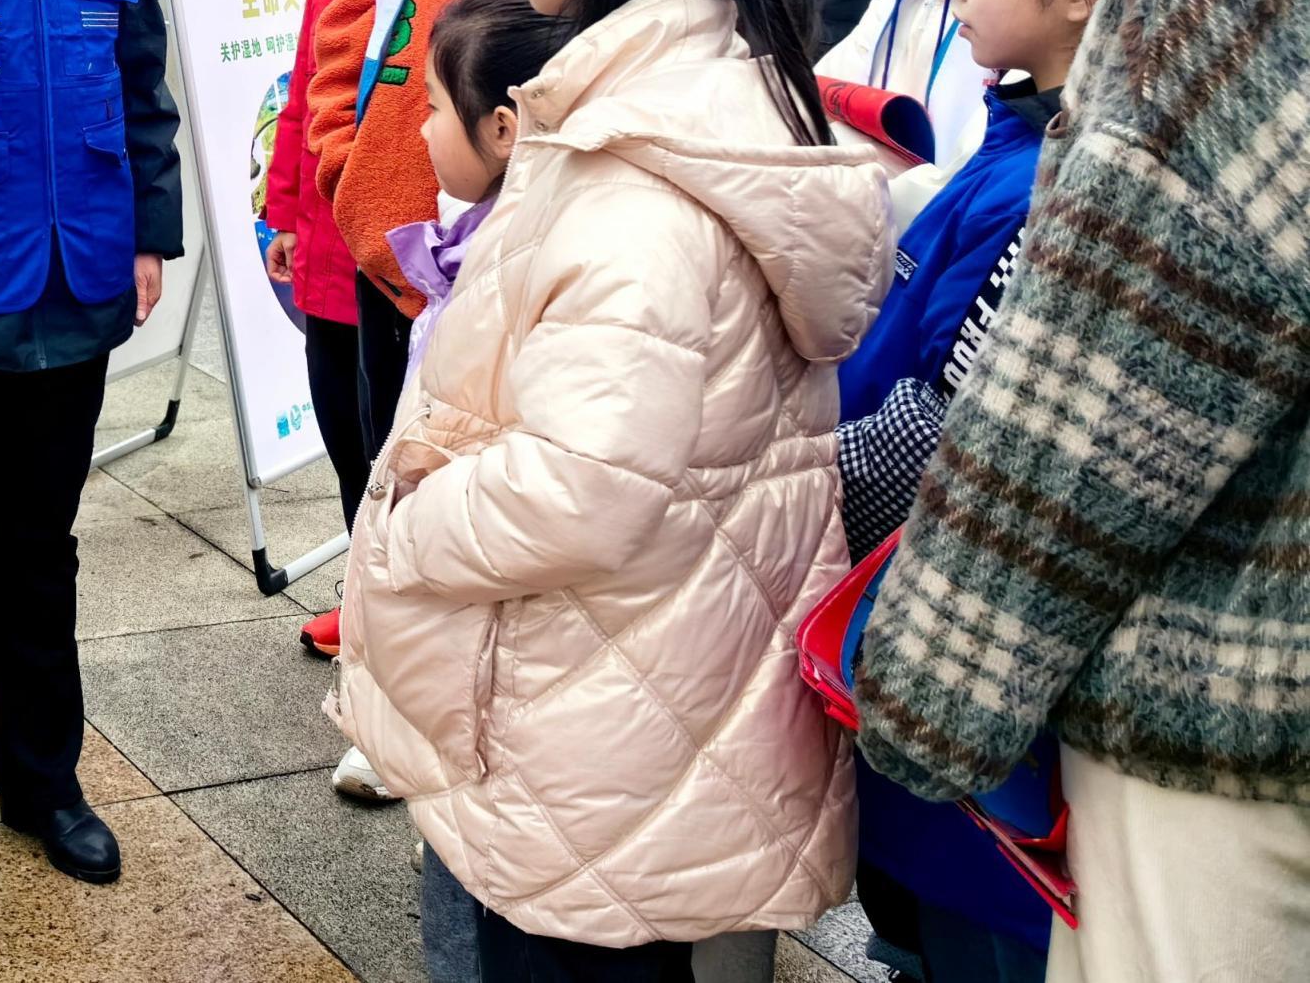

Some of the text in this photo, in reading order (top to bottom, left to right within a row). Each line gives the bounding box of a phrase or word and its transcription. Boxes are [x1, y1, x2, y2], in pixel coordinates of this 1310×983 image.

[220, 31, 299, 63] 关护湿地 呵护湿
